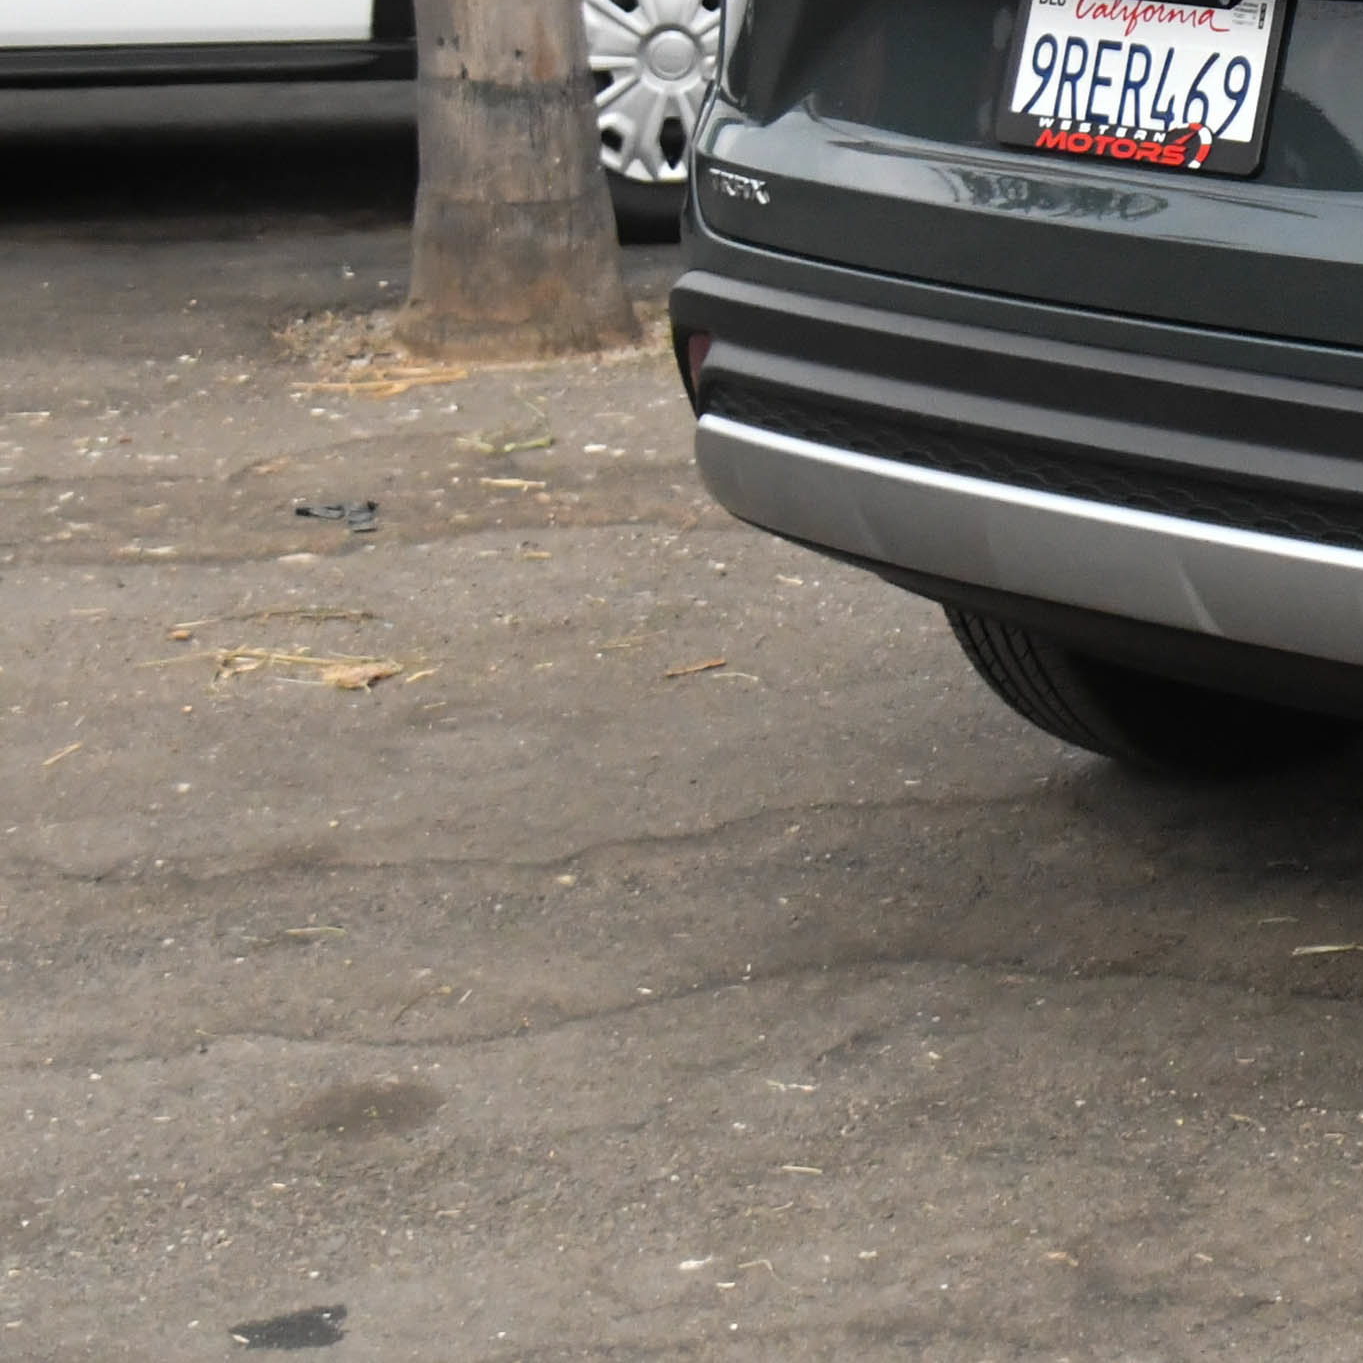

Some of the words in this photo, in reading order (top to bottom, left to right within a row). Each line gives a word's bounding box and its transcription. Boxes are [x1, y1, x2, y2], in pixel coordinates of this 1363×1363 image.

[1022, 32, 1252, 138] 9RER469
[1035, 127, 1188, 167] MOTORS
[1039, 116, 1167, 144] WESTERN
[708, 167, 771, 205] TRAX
